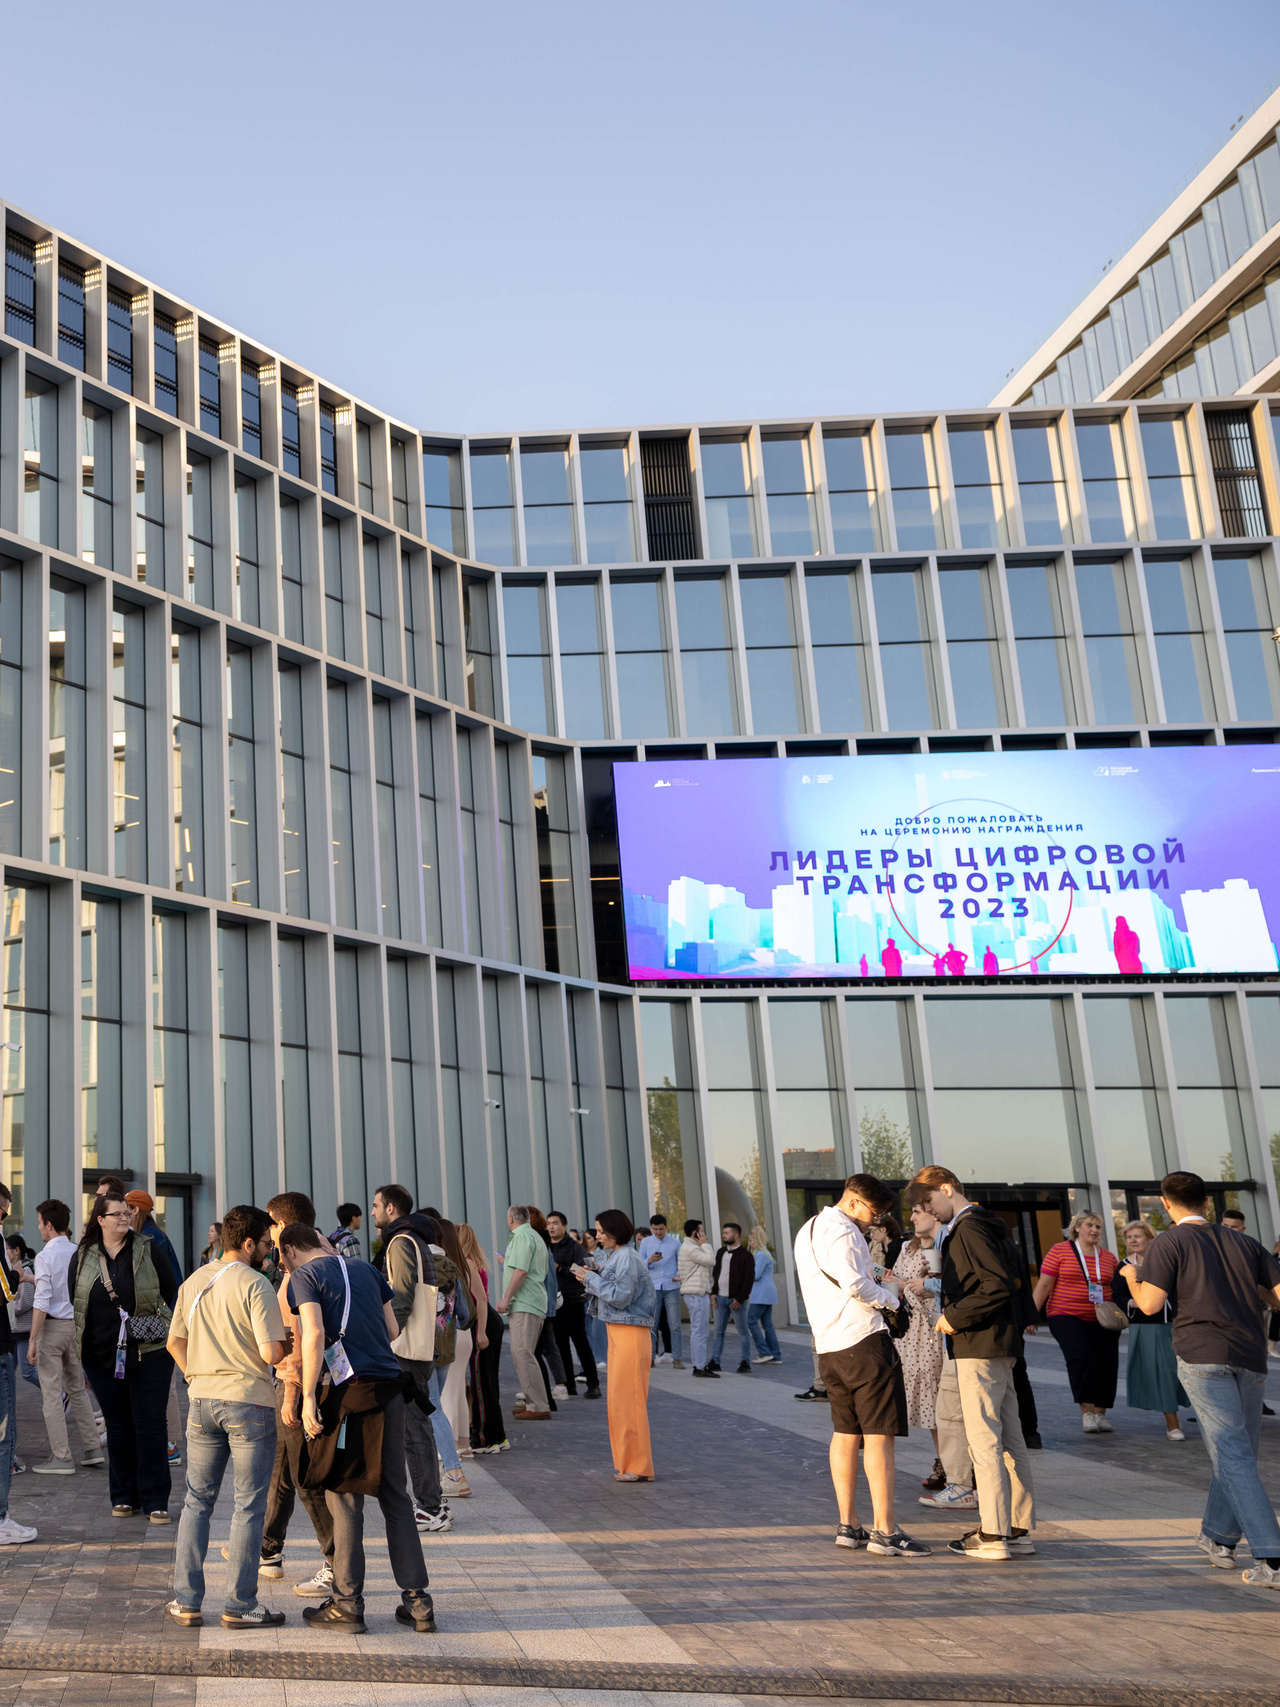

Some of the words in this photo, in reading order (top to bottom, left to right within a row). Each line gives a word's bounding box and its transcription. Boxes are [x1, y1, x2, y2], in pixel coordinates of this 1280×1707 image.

[860, 828, 878, 837] НА
[885, 826, 971, 837] ЦЕРЕМОНИЮ
[978, 824, 1084, 834] НАГРАЖДЕНИЯ
[895, 816, 941, 826] ДОБРО
[948, 814, 1043, 824] ПОЖАЛОВАТЬ
[769, 848, 933, 873] ЛИДЕРЫ
[955, 837, 1186, 871] ЦИФРОВОЙ
[796, 869, 1170, 896] ТРАНСФОРМАЦИИ
[938, 898, 1029, 919] 2023
